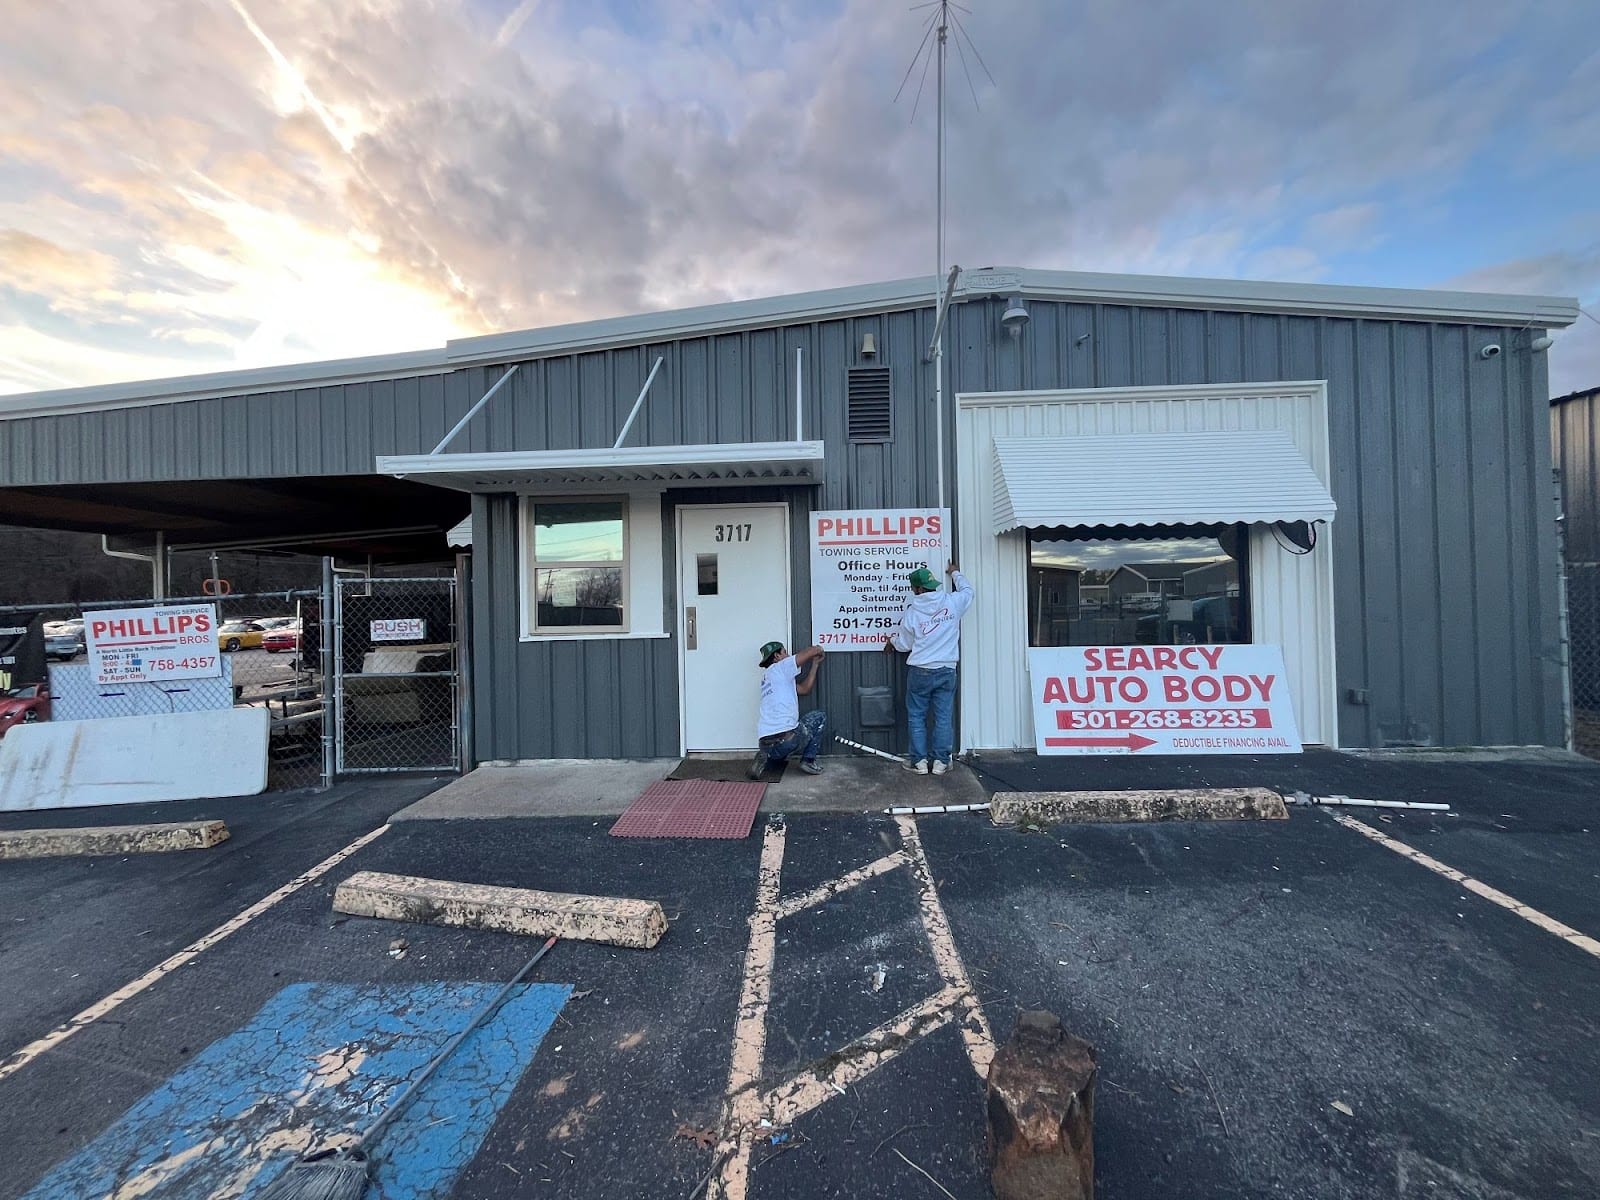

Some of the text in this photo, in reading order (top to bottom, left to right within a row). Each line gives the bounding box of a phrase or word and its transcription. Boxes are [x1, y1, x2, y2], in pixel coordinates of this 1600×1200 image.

[817, 515, 941, 537] PHILLIPS
[715, 524, 752, 542] 3717
[819, 547, 909, 557] TOWING SERVICE
[838, 559, 928, 571] Office Hours
[844, 574, 883, 582] Monday
[892, 573, 911, 581] Frid
[851, 585, 875, 593] 9am.
[861, 594, 907, 602] Saturday
[154, 607, 209, 617] TOWING SERVICE
[839, 604, 904, 614] Appointment
[92, 614, 211, 639] PHILLIPS
[374, 621, 420, 633] PUSH
[833, 617, 903, 629] 501-758-
[179, 634, 212, 645] BROS.
[819, 633, 847, 644] 3717
[851, 632, 887, 643] Harold
[148, 656, 216, 672] 758-4357
[1083, 646, 1225, 672] SEARCY
[110, 674, 128, 682] Appt
[1042, 674, 1276, 704] AUTO BODY
[1070, 709, 1257, 729] 501-268-8235
[1172, 738, 1222, 748] DEDUCTIBLE
[1223, 737, 1265, 748] FINANCING
